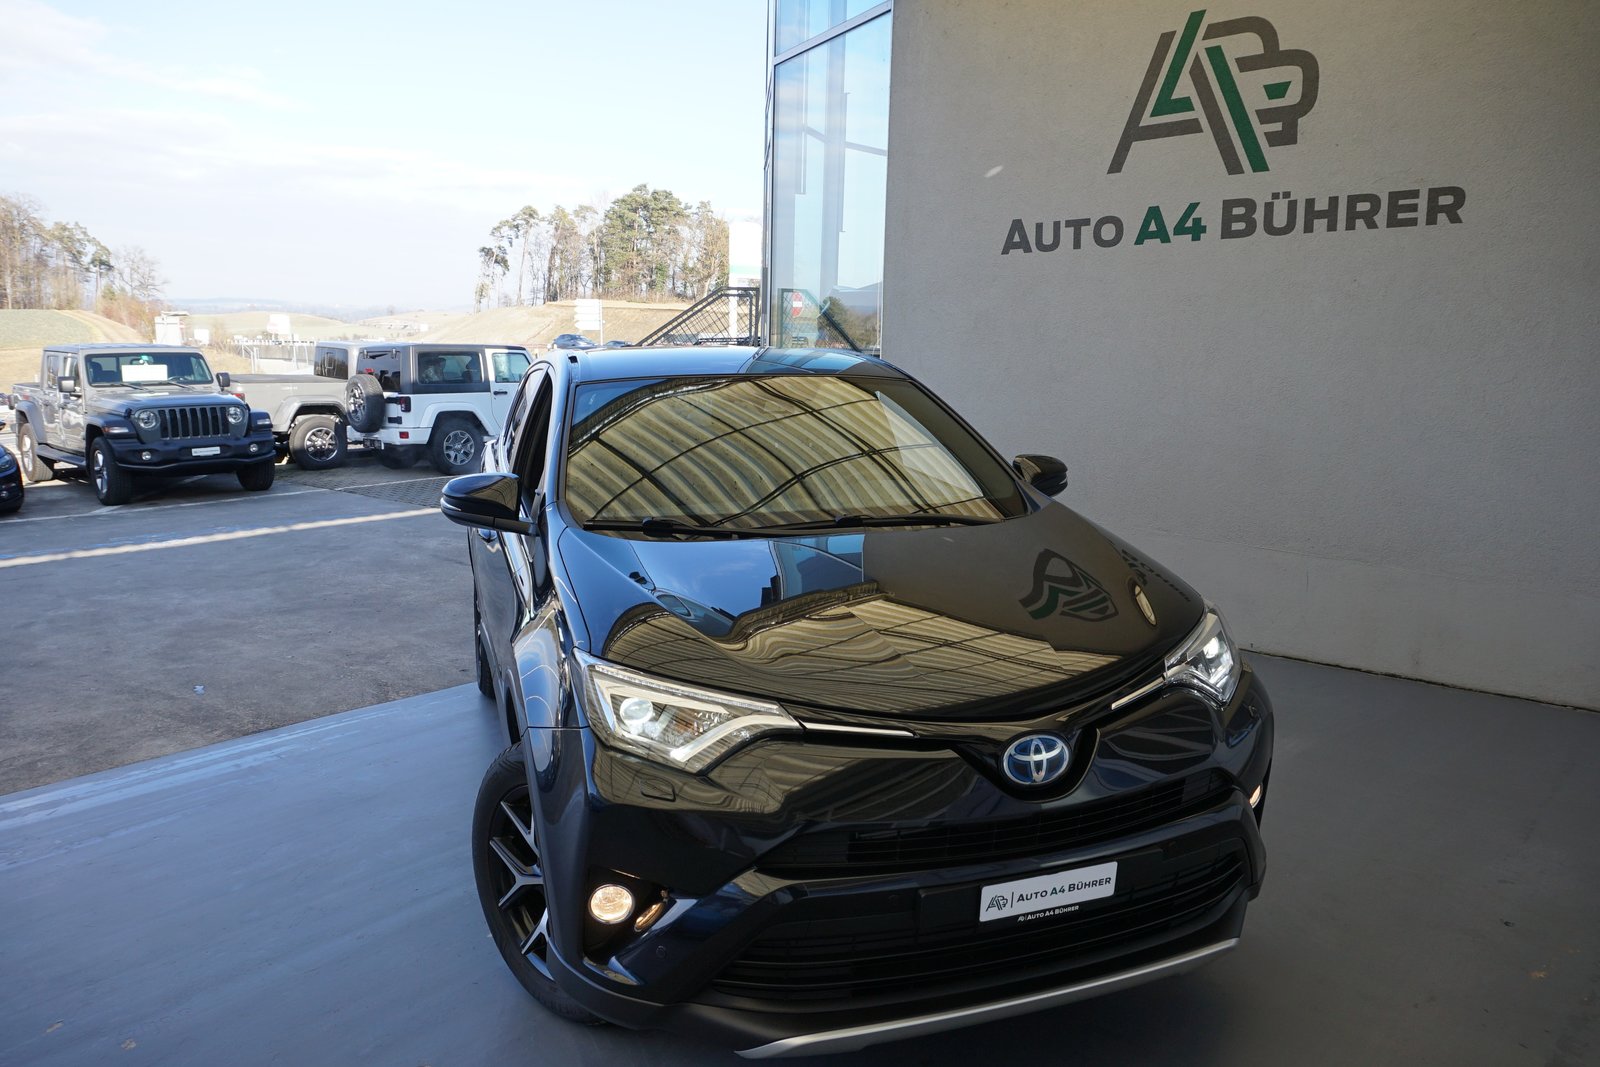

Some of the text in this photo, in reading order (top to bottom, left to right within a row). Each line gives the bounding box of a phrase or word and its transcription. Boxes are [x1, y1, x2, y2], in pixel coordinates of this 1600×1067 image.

[1001, 185, 1466, 255] AUTO A4 BÜHRER
[1016, 889, 1048, 903] AUTO
[1050, 885, 1066, 896] A4
[1068, 877, 1112, 892] BÜHRER
